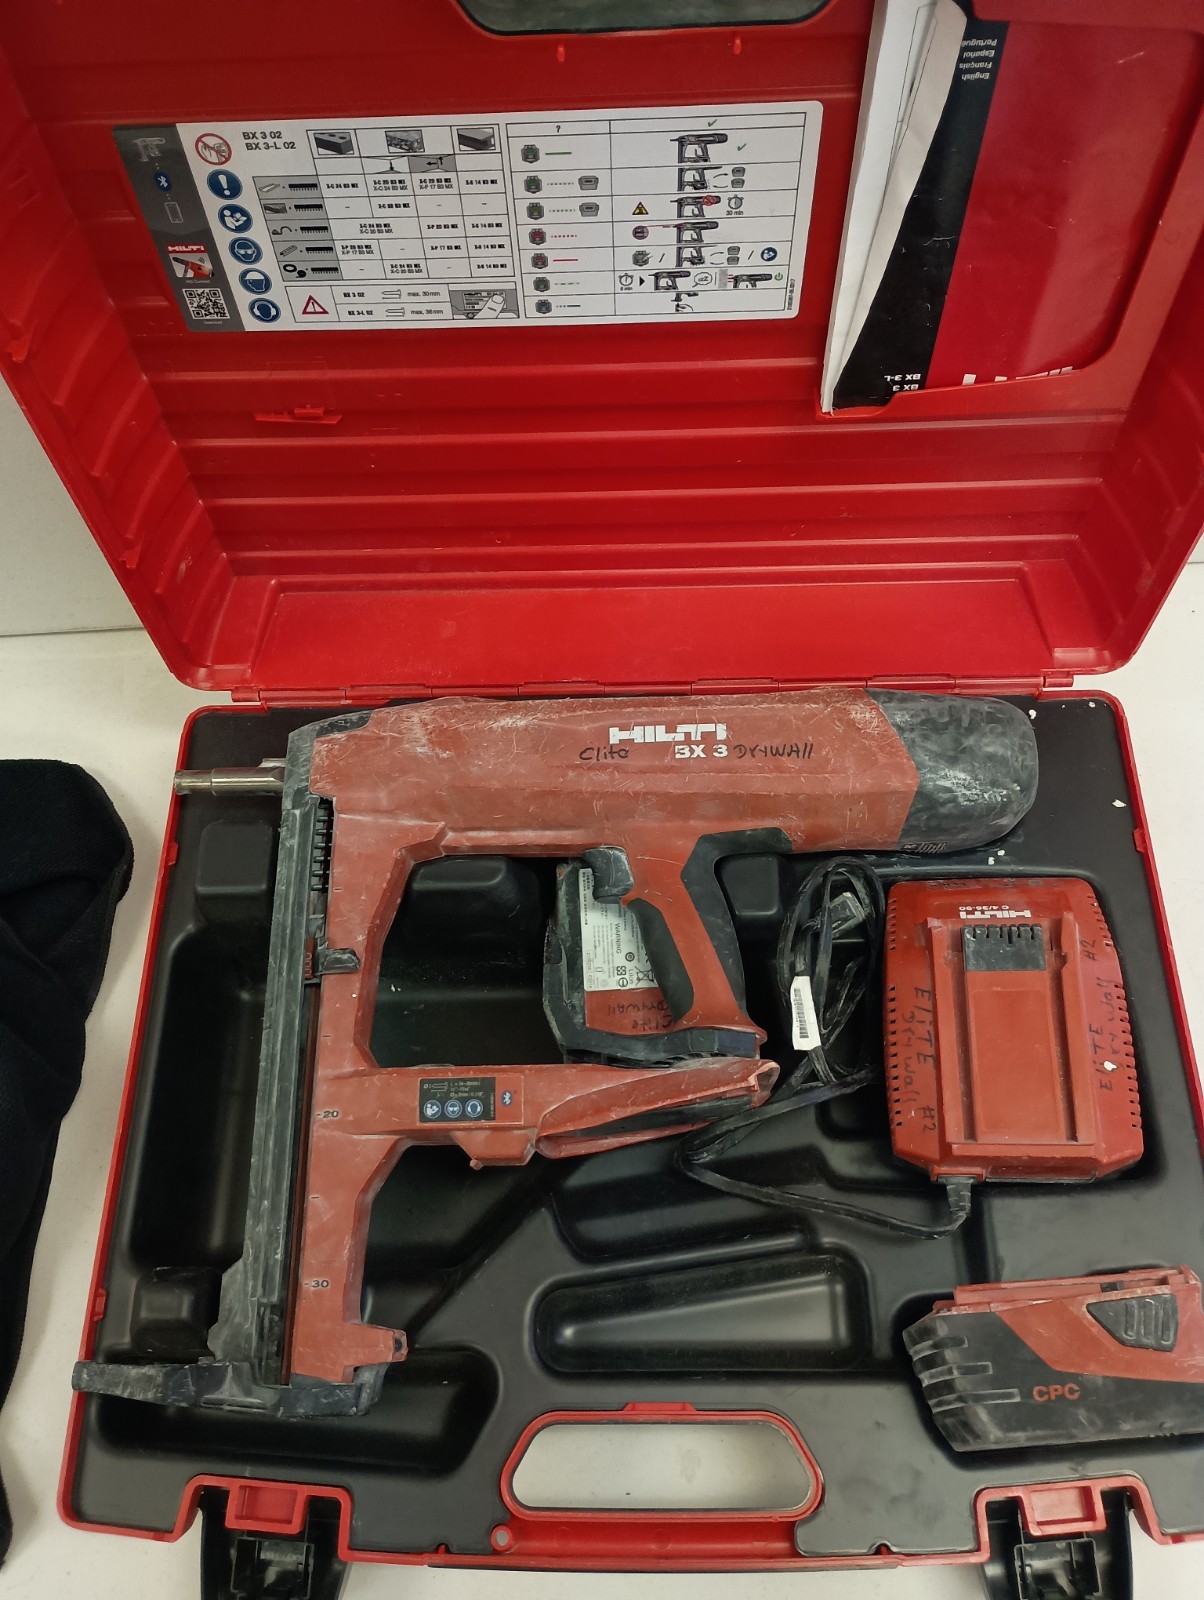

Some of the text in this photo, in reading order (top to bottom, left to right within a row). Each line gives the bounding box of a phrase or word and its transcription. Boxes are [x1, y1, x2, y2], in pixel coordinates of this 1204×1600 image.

[964, 50, 995, 59] Español
[959, 60, 992, 70] Français
[961, 72, 990, 80] English
[609, 724, 727, 744] HILTI
[675, 744, 728, 759] BX 3
[959, 909, 1032, 919] HILTI
[1032, 1383, 1080, 1401] CPC
